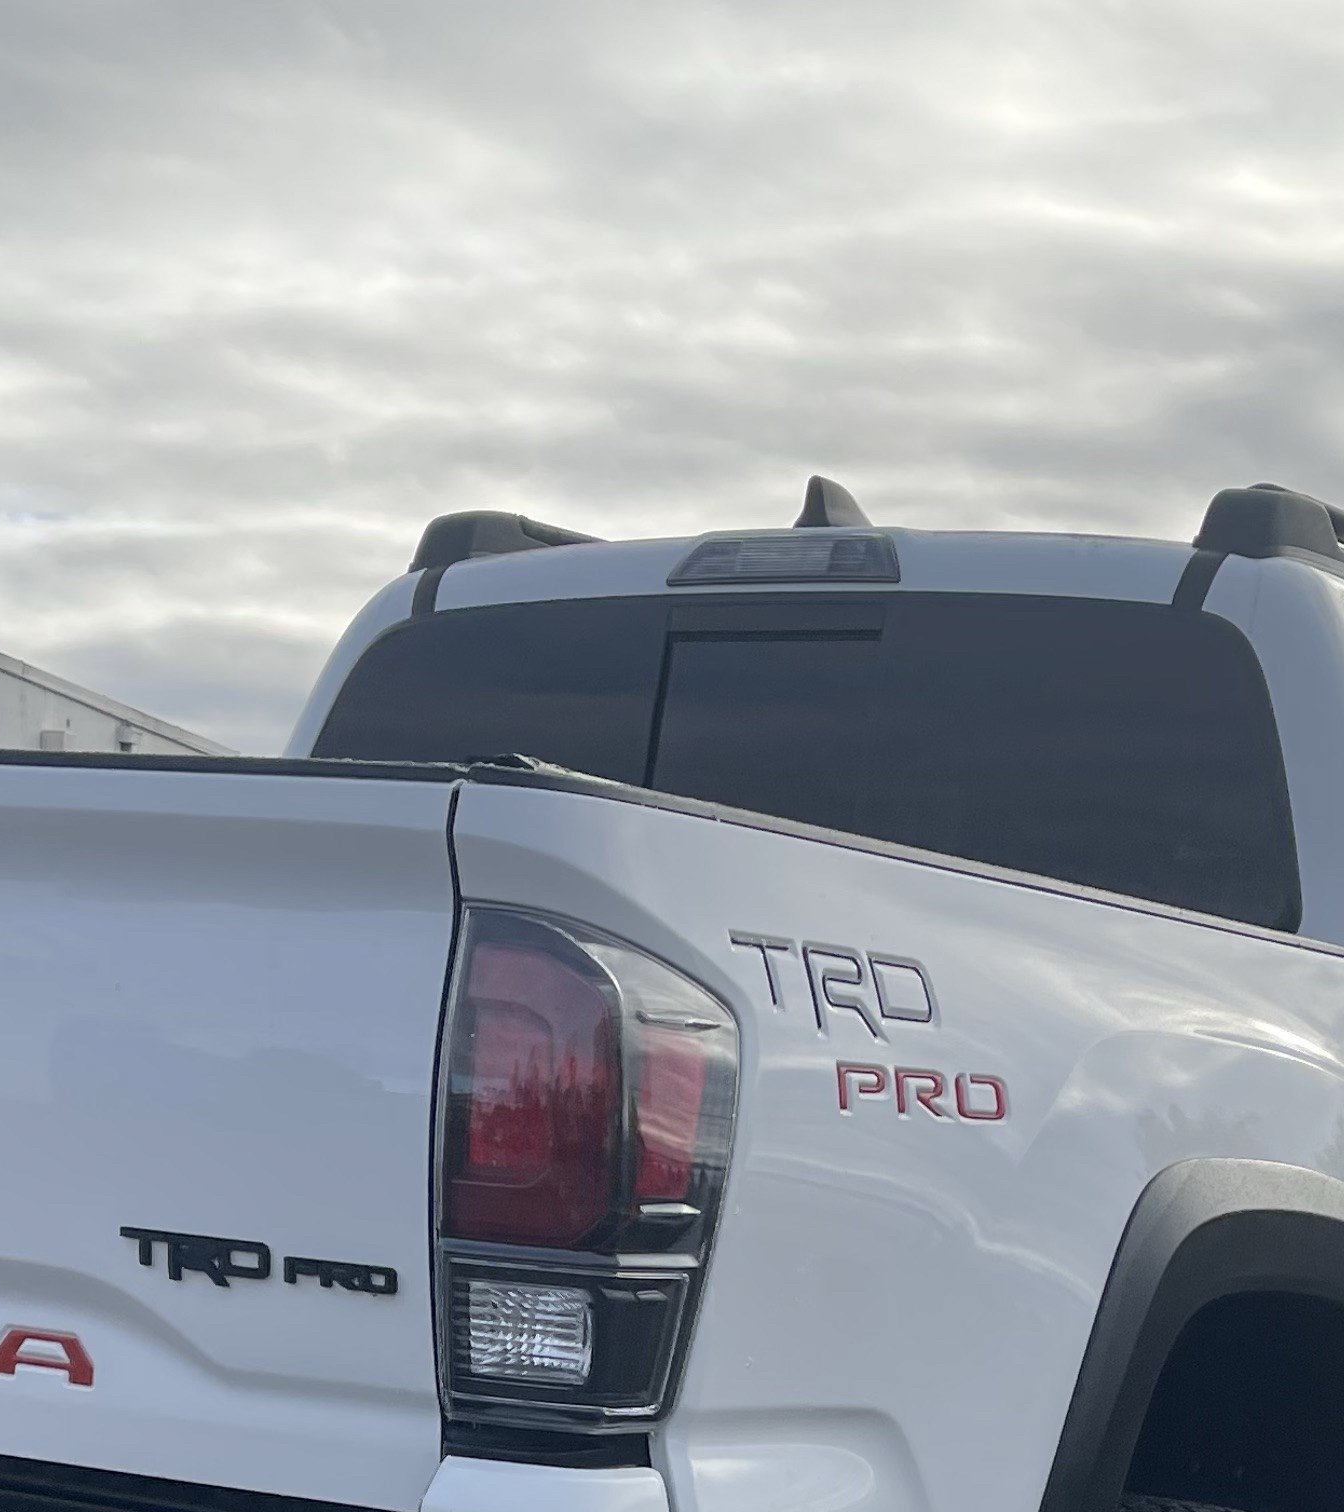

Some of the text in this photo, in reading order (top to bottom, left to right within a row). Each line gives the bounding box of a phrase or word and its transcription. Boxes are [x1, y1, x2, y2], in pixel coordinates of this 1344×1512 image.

[728, 929, 941, 1046] TRD
[836, 1060, 1008, 1123] PRO
[120, 1226, 398, 1294] TRD PRO
